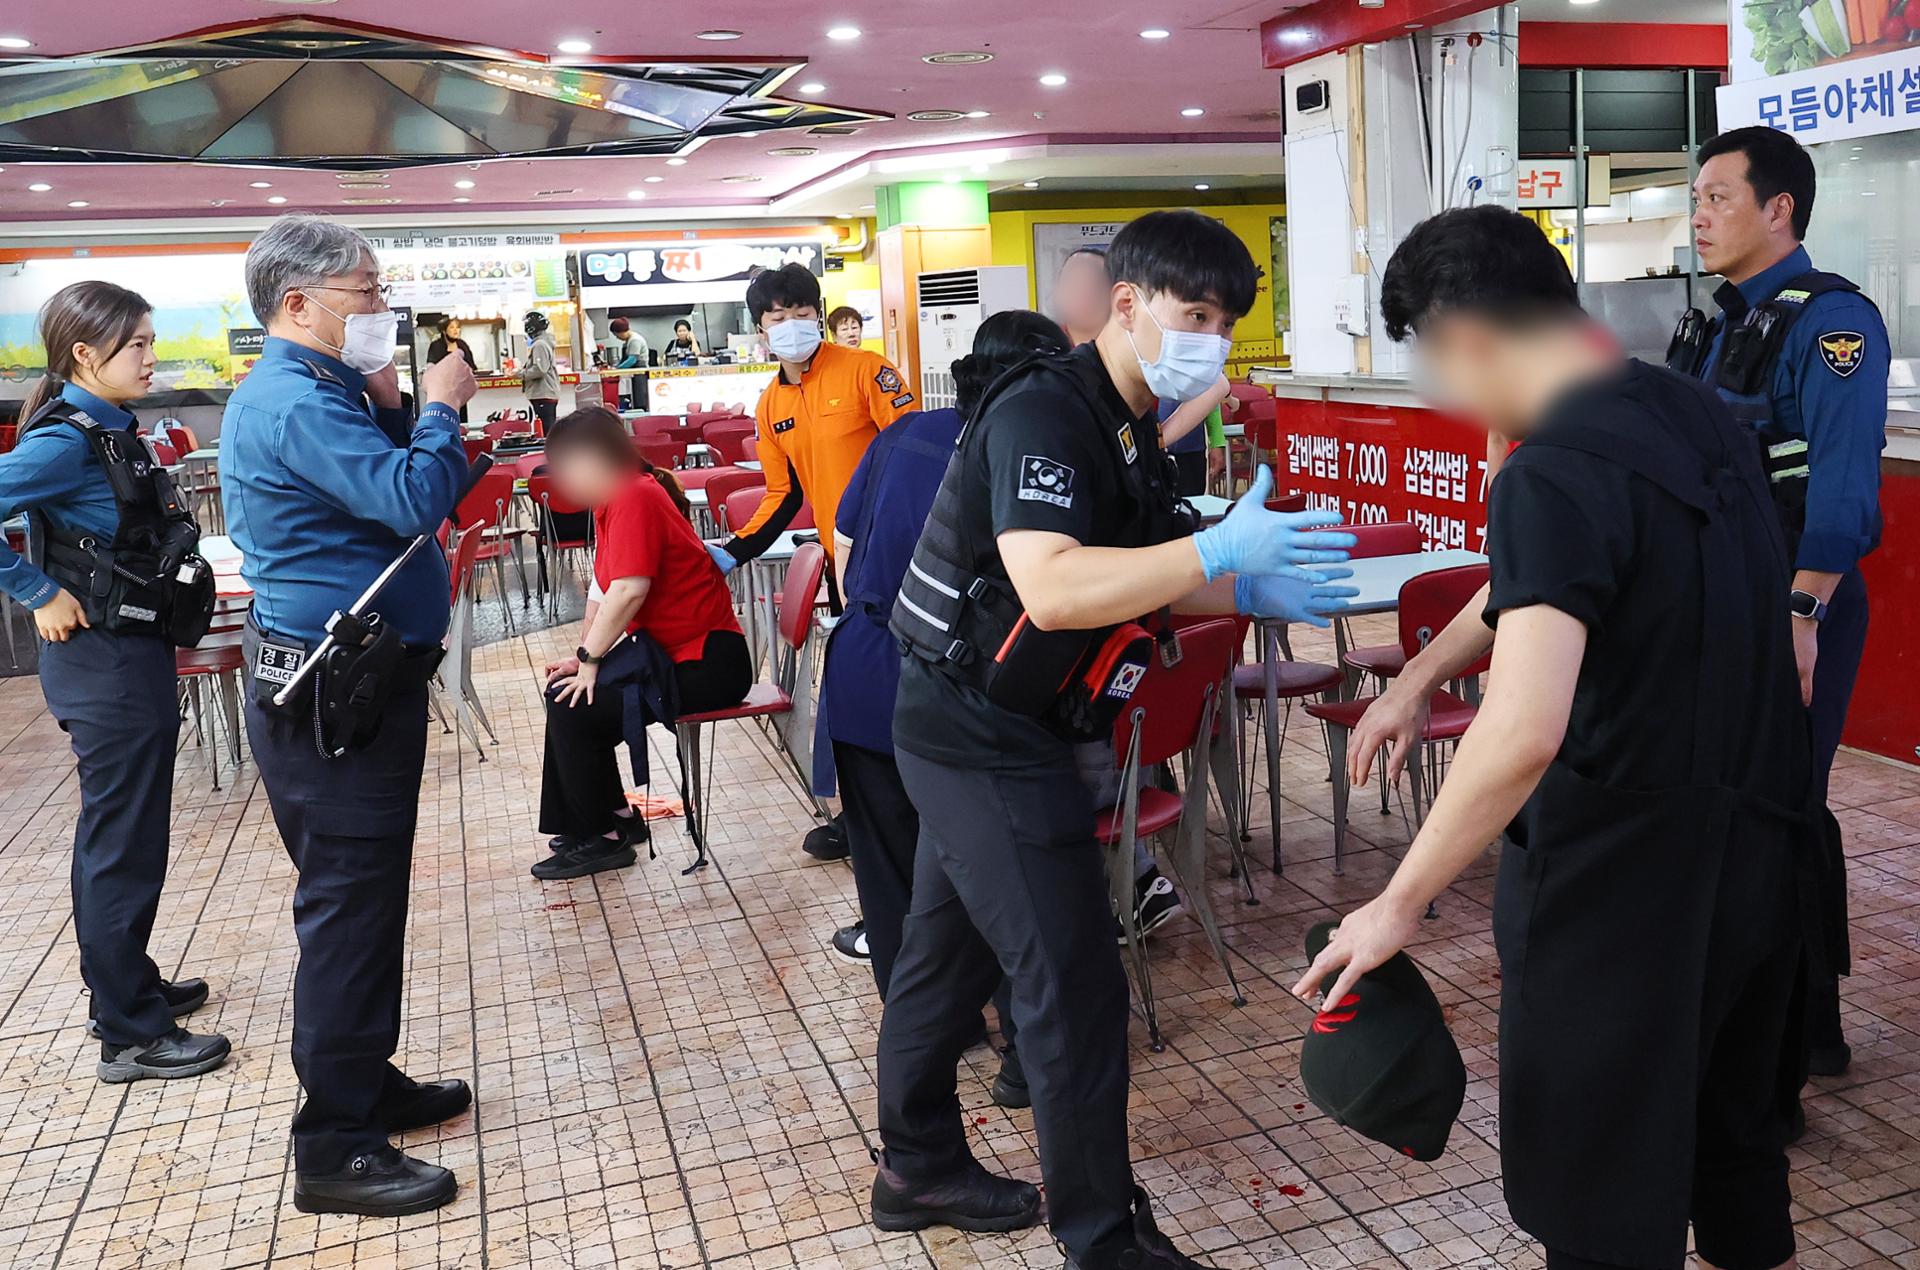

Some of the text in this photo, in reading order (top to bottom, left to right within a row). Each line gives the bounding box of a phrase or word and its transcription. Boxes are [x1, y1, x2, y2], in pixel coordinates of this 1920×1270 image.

[1287, 433, 1489, 503] 갈비쌈밥 7,000 삼겹쌈밥 7
[1022, 490, 1067, 506] KOREA
[260, 667, 295, 681] POLICE
[1107, 689, 1131, 699] KOREA
